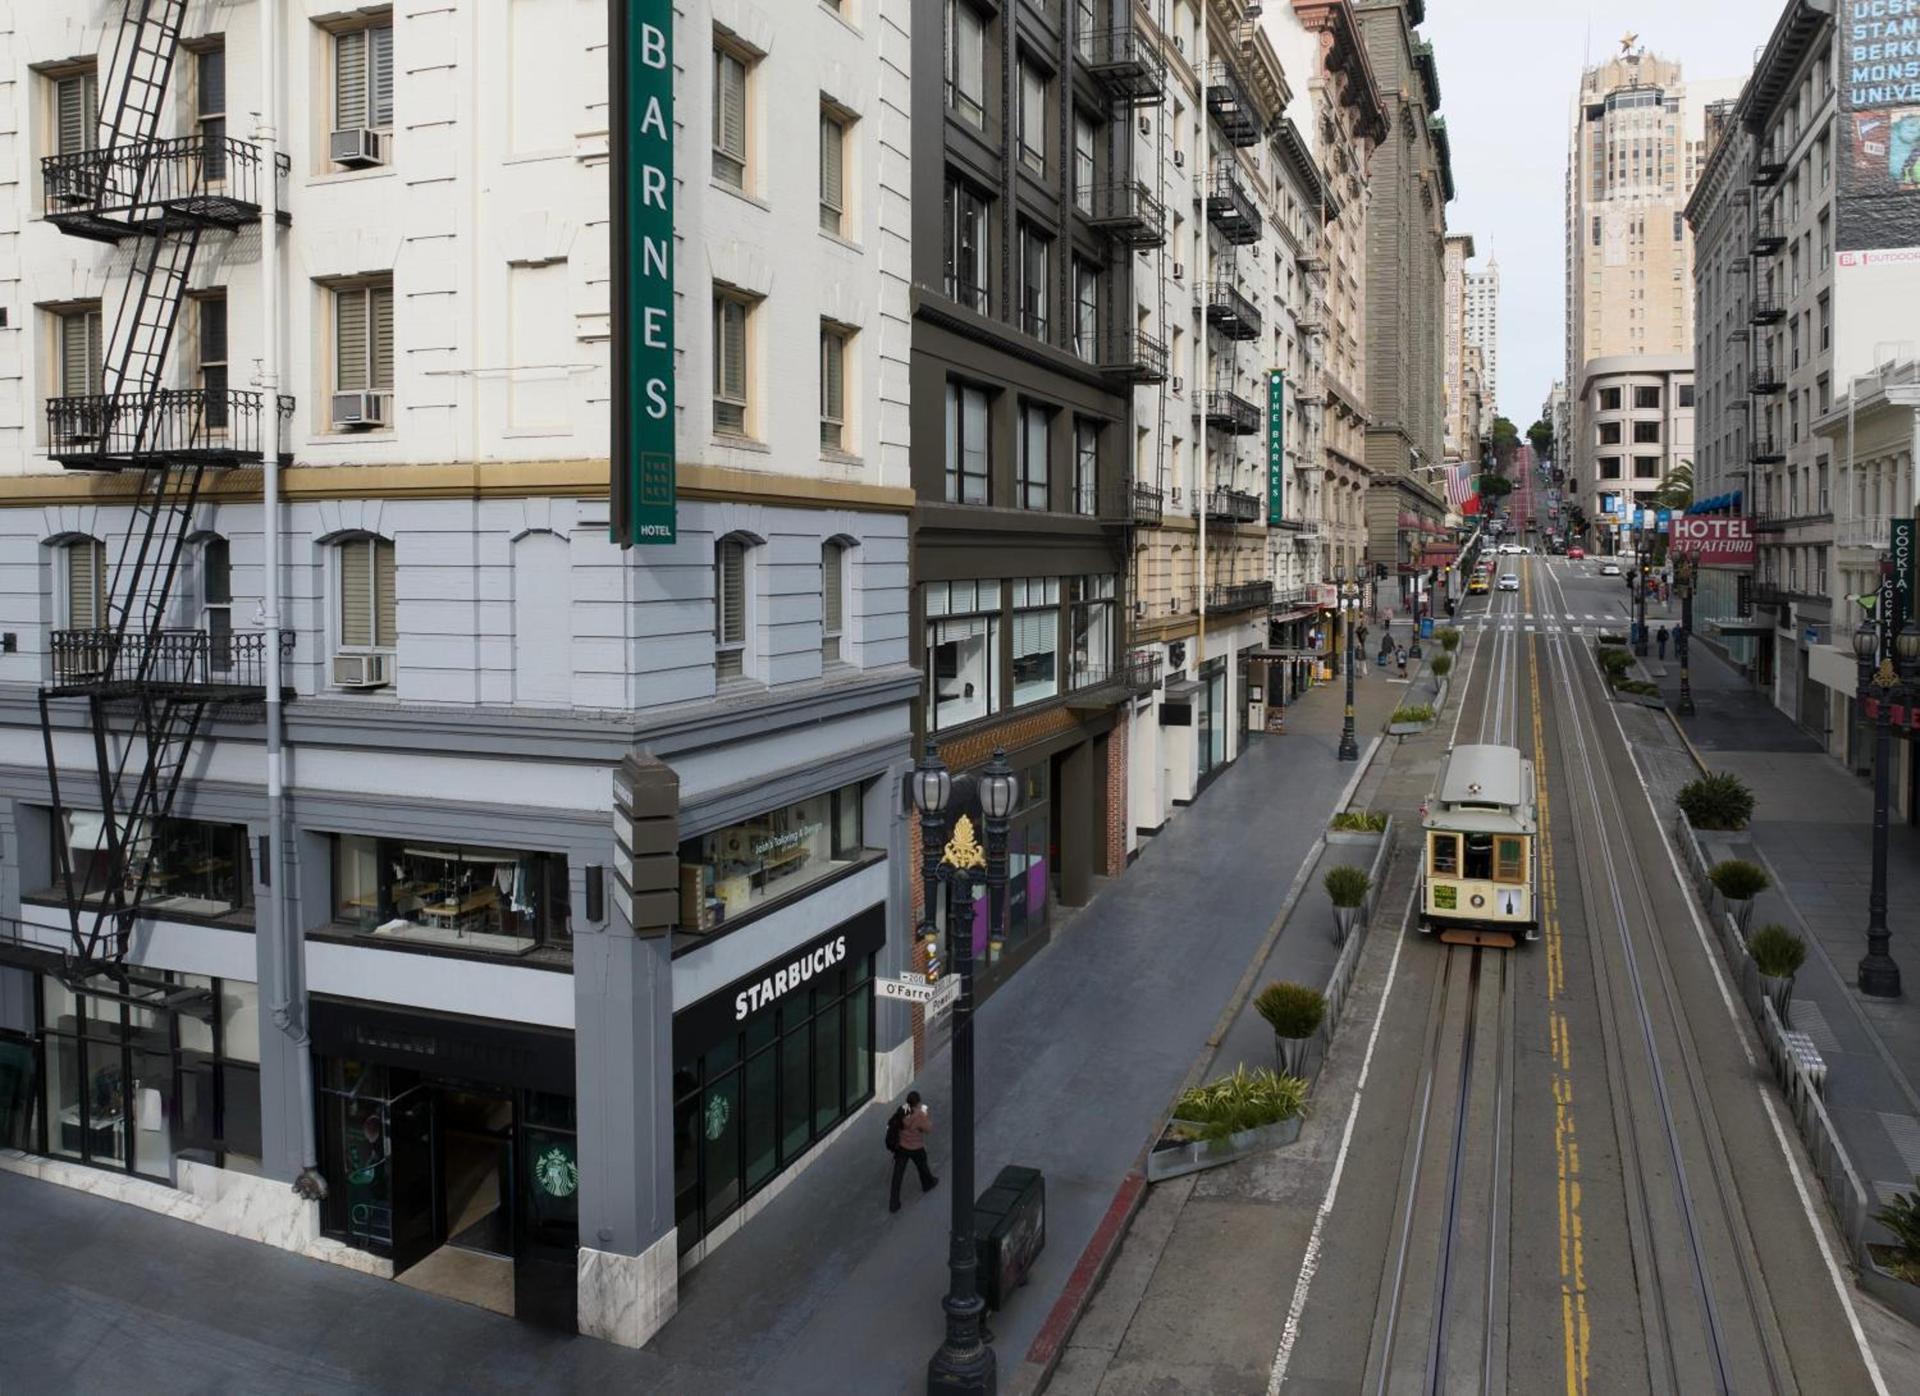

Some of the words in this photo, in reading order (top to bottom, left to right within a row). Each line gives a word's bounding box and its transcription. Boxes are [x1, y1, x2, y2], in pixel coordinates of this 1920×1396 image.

[1854, 0, 1918, 19] UCSF
[640, 22, 668, 420] BARNES
[1272, 430, 1280, 497] BARNES
[641, 524, 672, 537] HOTEL
[1674, 520, 1752, 538] HOTEL
[1896, 525, 1909, 592] COCKTA
[1884, 580, 1894, 660] COCKTAIL
[735, 935, 846, 1021] STARBUCKS
